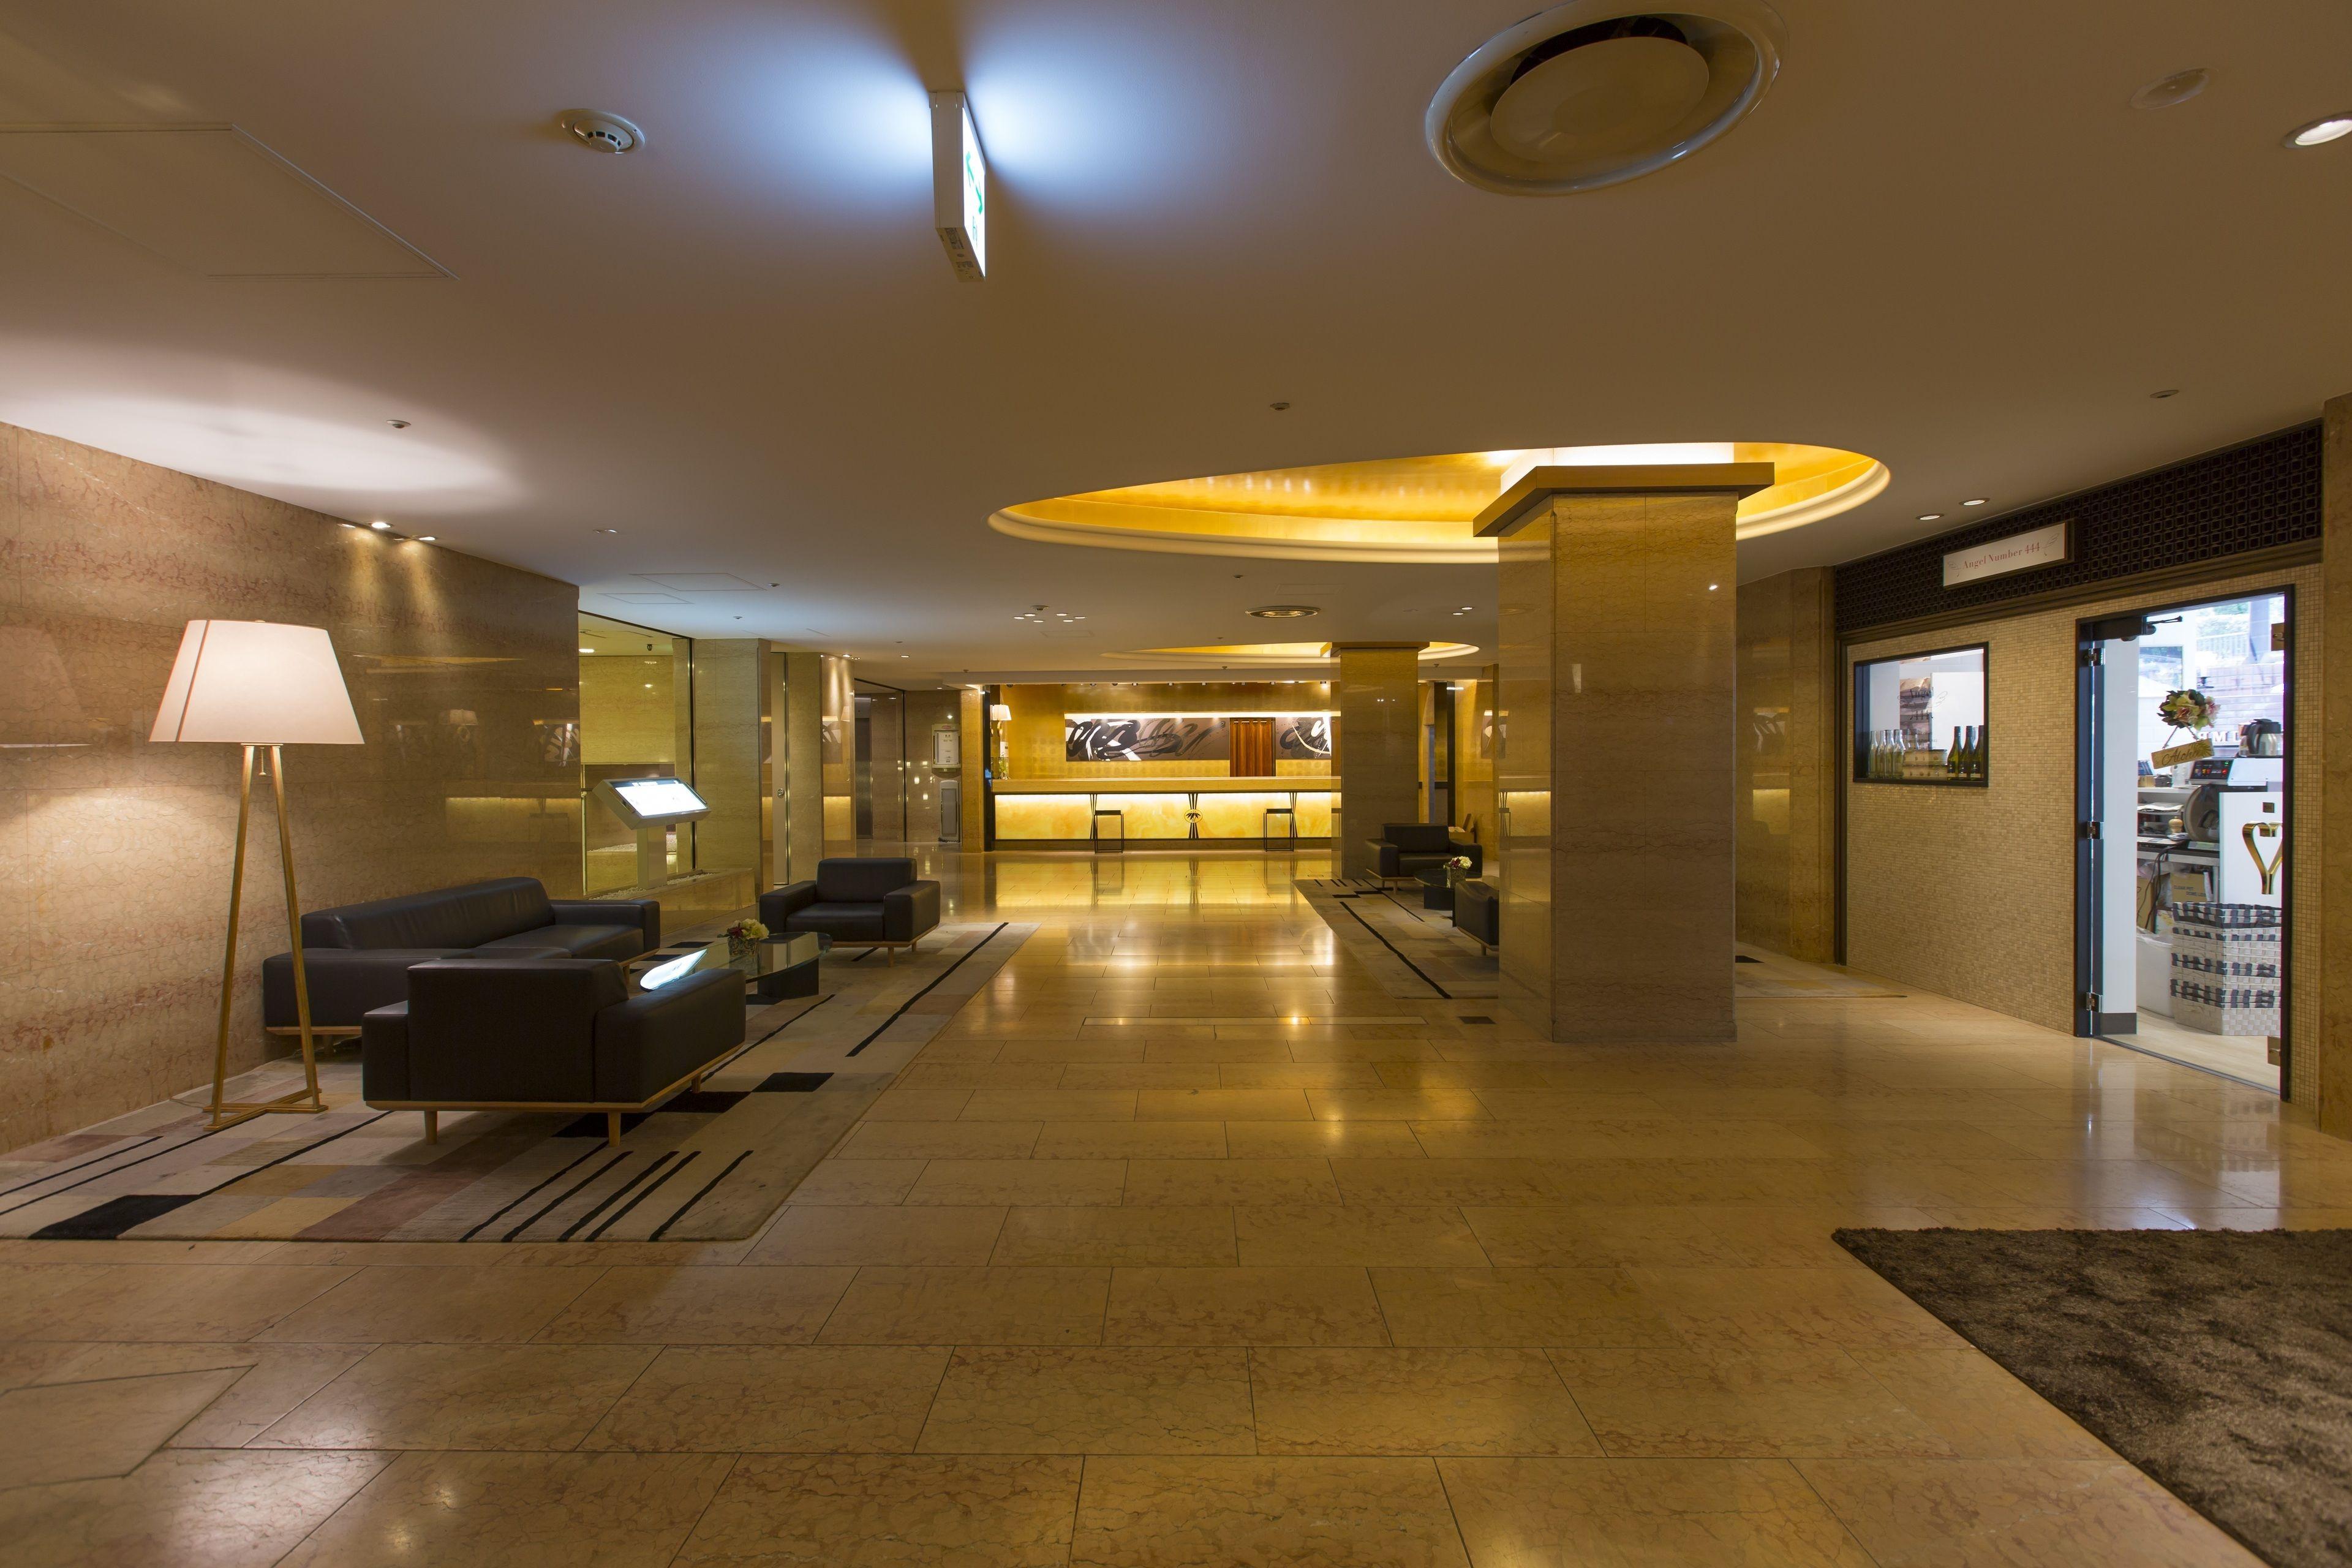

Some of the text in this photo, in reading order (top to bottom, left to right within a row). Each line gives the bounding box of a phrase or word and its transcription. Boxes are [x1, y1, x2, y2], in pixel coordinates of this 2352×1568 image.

[1962, 542, 2040, 569] Angel Number 444
